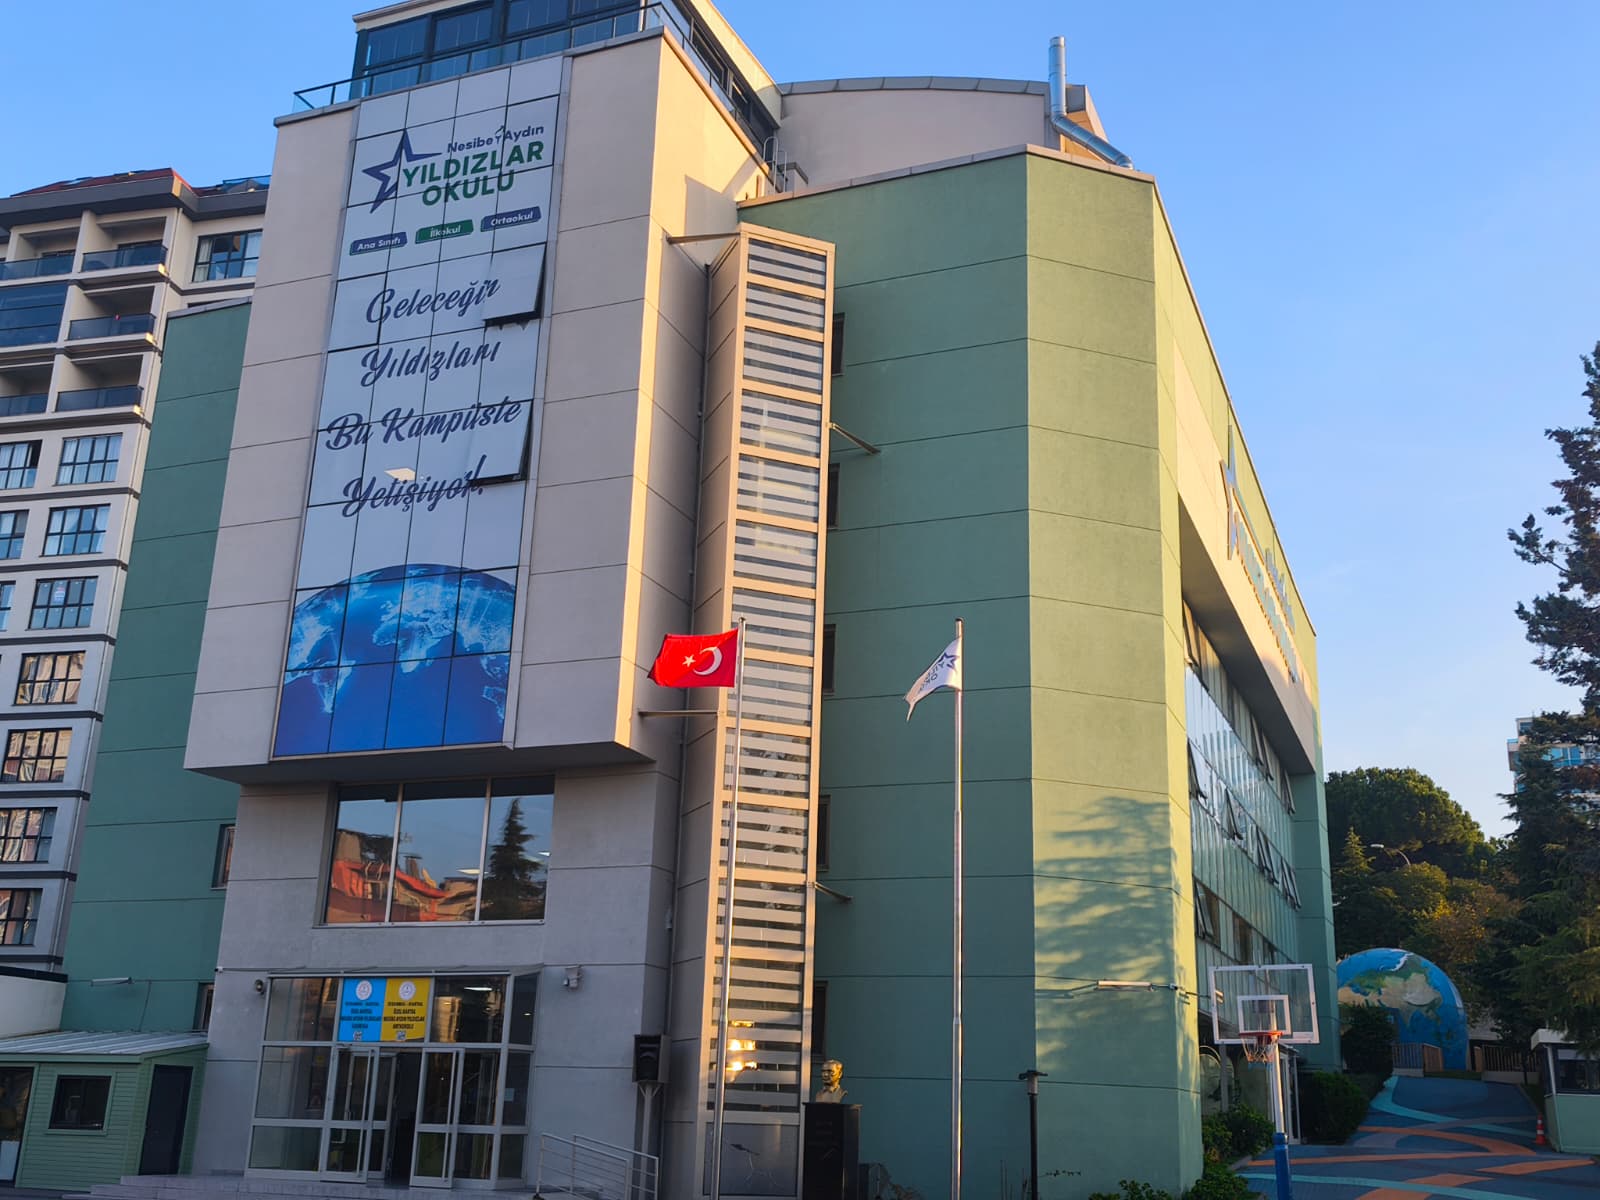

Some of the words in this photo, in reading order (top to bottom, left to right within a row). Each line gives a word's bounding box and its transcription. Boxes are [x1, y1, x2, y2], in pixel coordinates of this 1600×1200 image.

[447, 136, 493, 153] Nesibe
[504, 125, 545, 142] Aydın
[402, 140, 545, 187] YILDIZLAR
[422, 169, 515, 206] OKULU
[490, 211, 534, 226] Ortaokul
[356, 242, 376, 251] Ana
[325, 413, 374, 450] Bu
[381, 396, 522, 443] Kampüste
